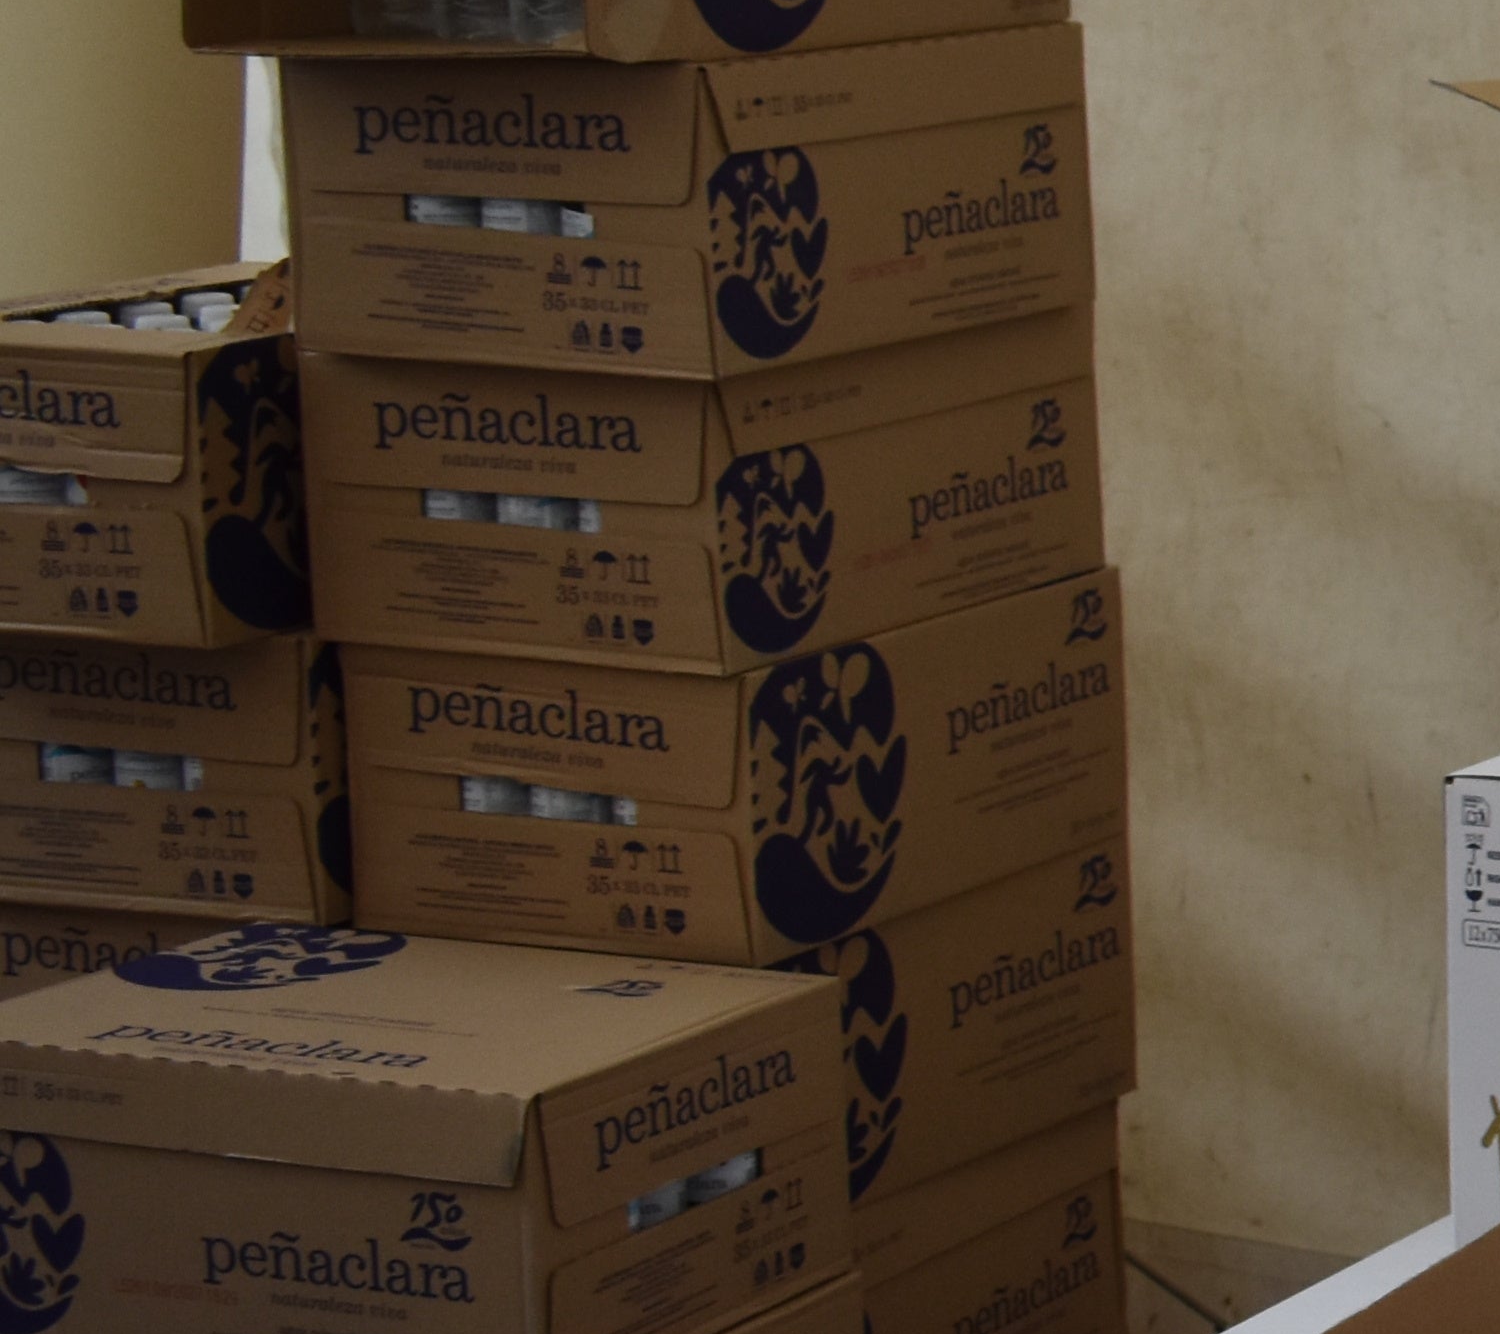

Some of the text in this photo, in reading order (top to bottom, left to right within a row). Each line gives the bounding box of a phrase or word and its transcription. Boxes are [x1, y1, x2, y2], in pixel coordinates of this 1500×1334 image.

[353, 94, 632, 155] peñaclara
[902, 178, 1062, 256] peñaclara
[373, 392, 643, 453] peñaclara
[908, 455, 1069, 540] peñaclara
[408, 683, 670, 752] peñaclara
[946, 661, 1111, 755] peñaclara
[949, 926, 1122, 1029] peñaclara
[87, 1021, 430, 1070] peñaclara
[594, 1050, 797, 1173] peñaclara
[201, 1231, 475, 1303] peñaclara
